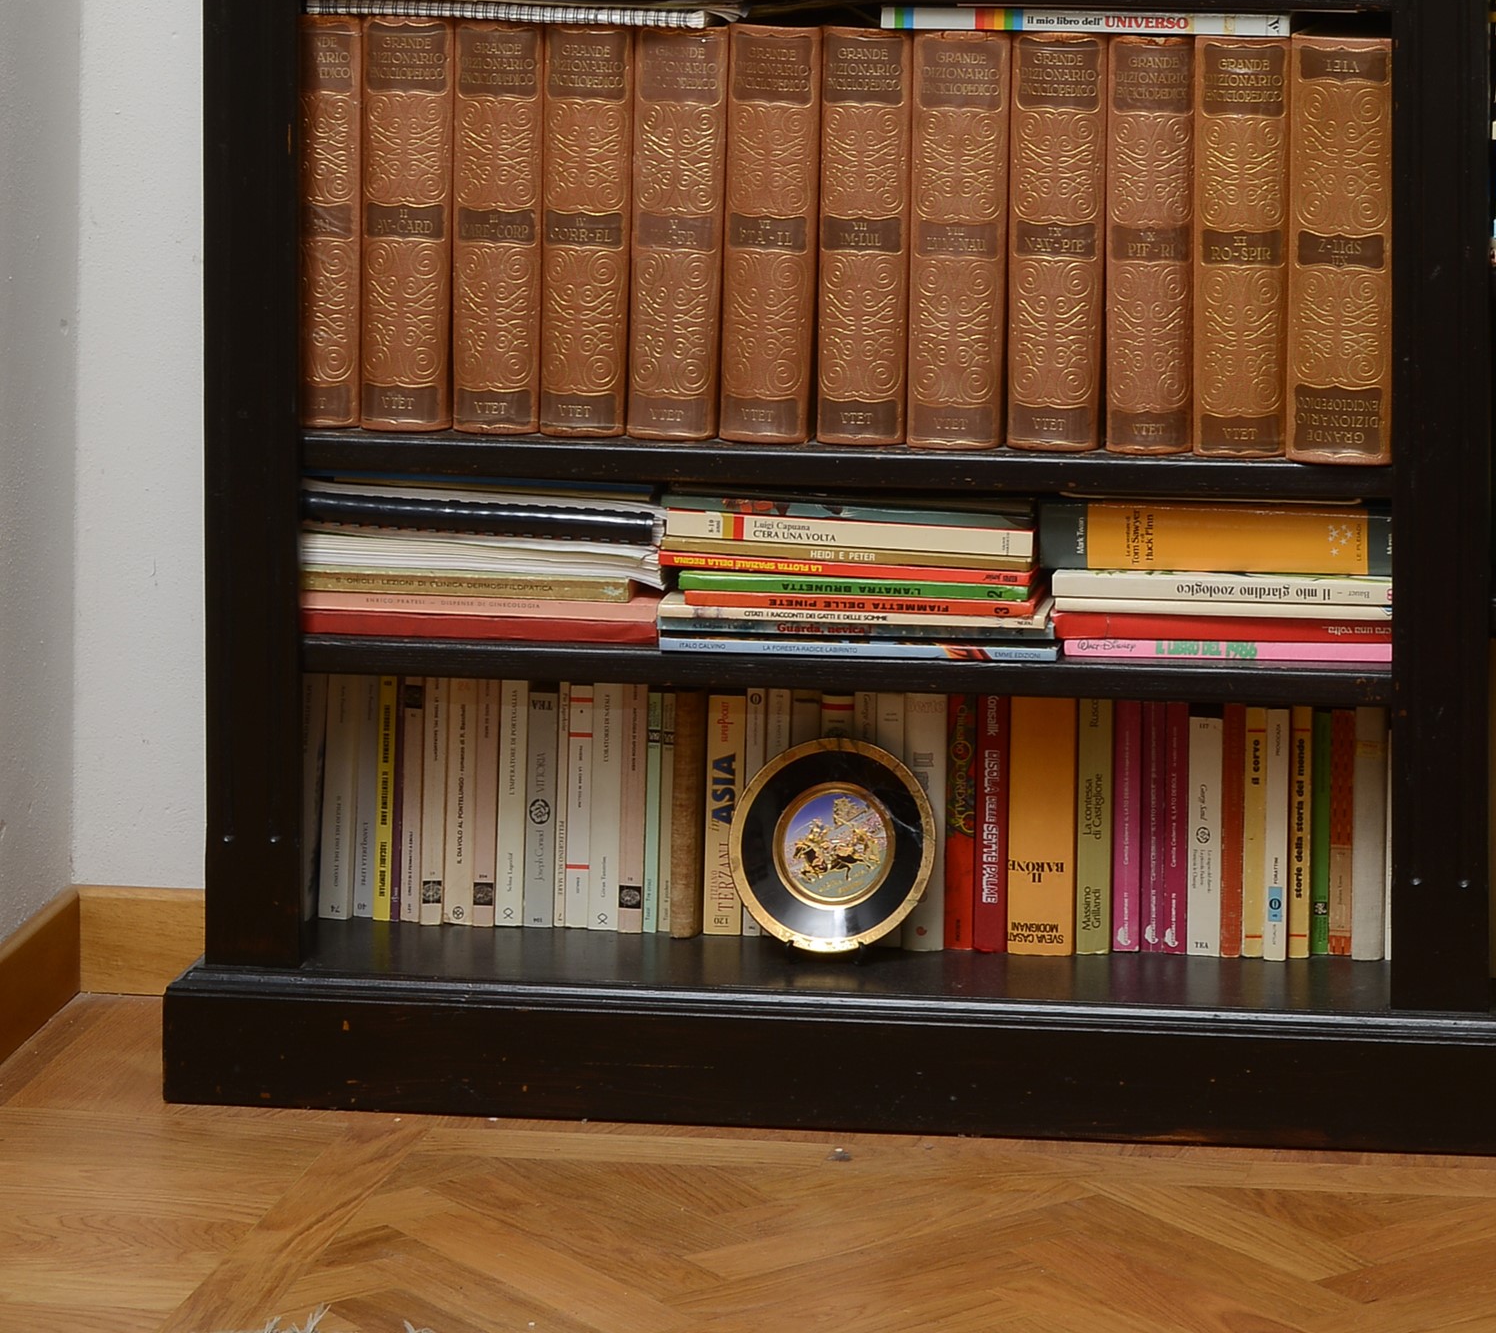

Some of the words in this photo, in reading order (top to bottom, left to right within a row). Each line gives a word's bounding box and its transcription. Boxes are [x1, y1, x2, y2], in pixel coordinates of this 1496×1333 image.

[1105, 16, 1189, 30] UNIVERSO
[753, 530, 778, 540] C'ERA
[783, 531, 802, 541] UNA
[805, 532, 837, 542] VOLTA
[810, 550, 834, 560] HEIDI
[838, 552, 846, 561] E
[850, 552, 875, 561] PETER
[712, 753, 737, 824] ASIA
[718, 842, 735, 912] TERZANI
